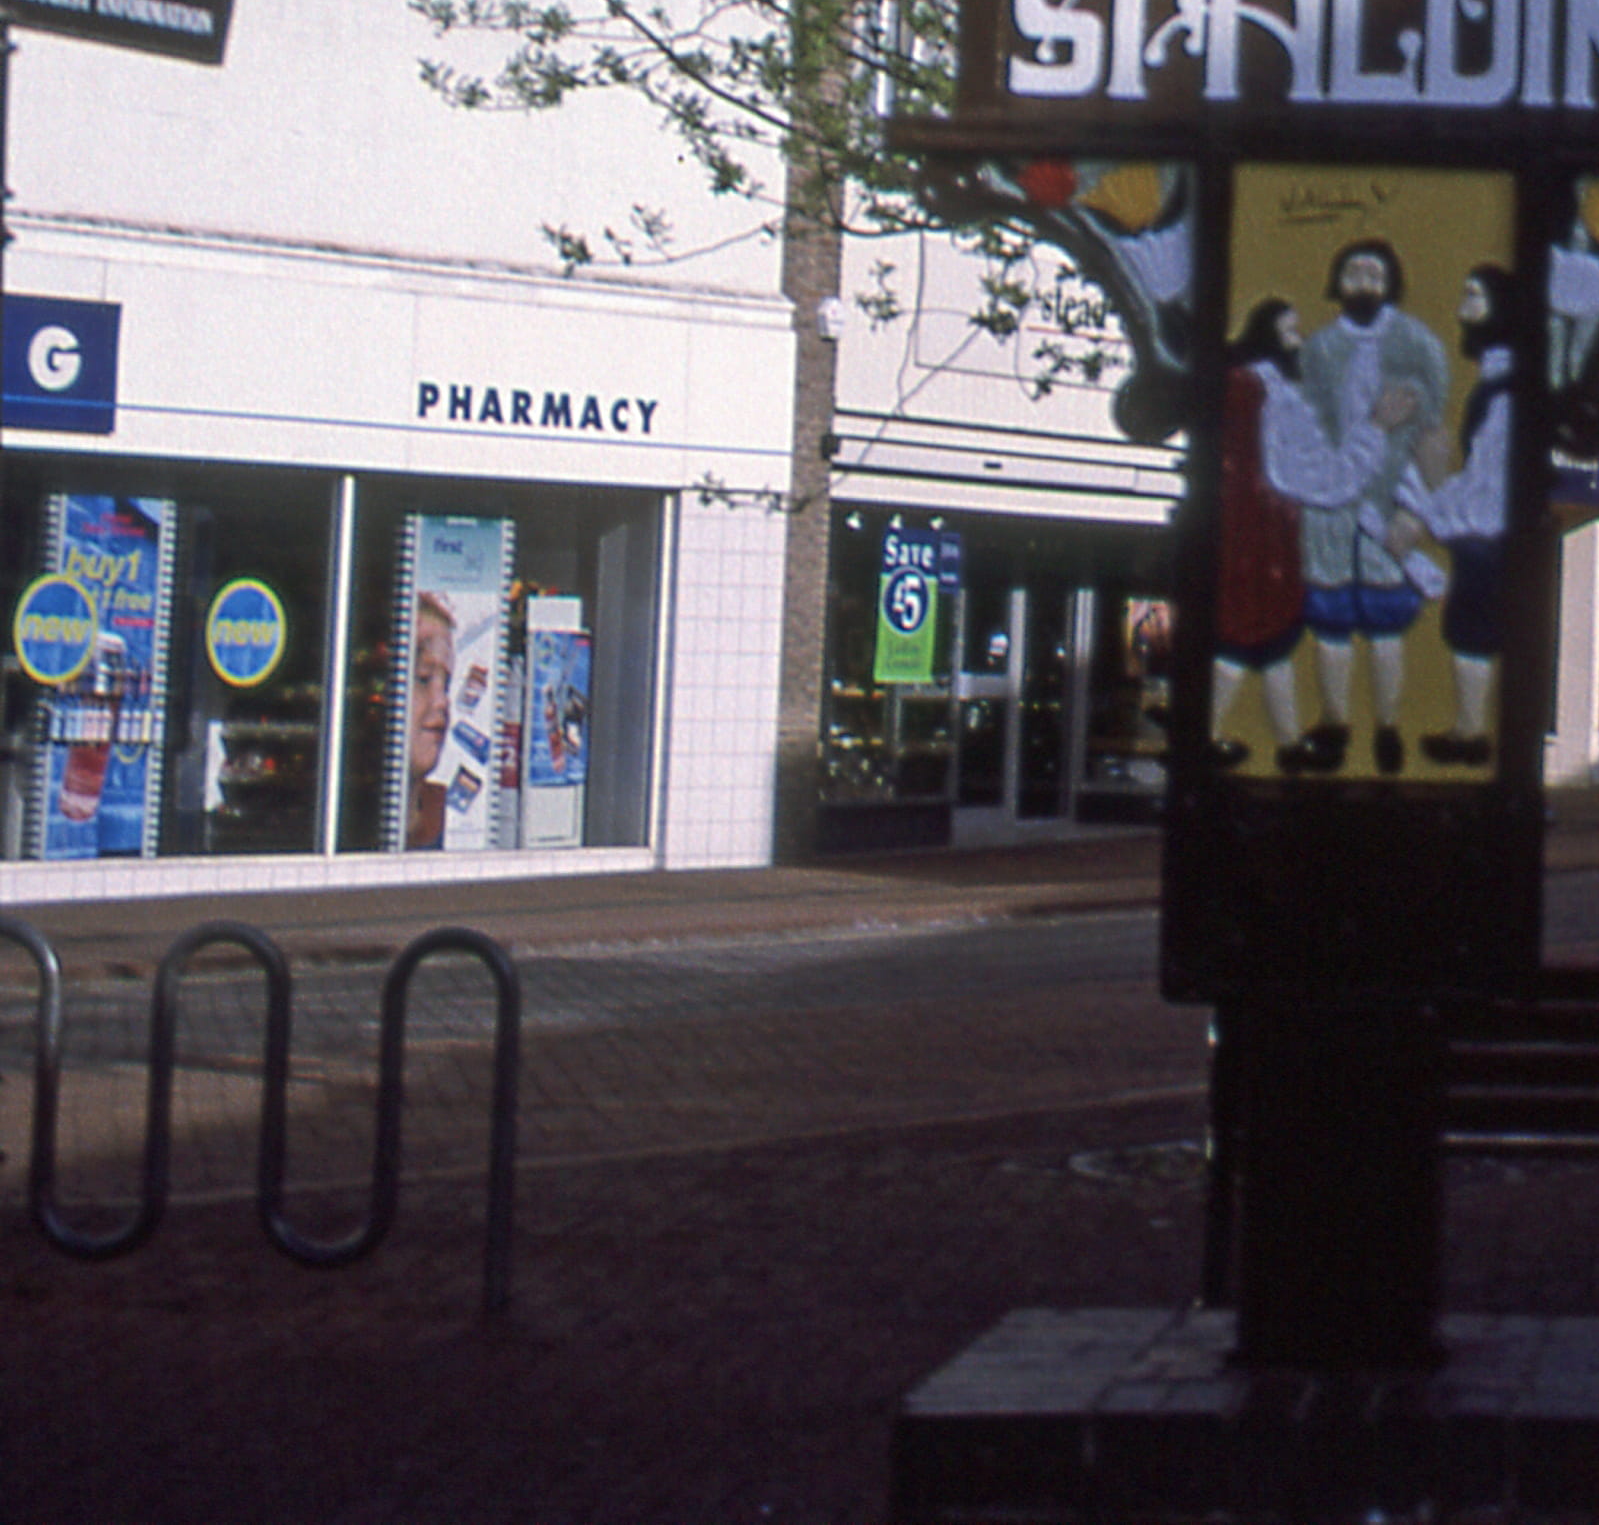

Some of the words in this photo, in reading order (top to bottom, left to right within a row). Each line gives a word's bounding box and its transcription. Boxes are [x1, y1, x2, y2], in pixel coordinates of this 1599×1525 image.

[27, 324, 83, 393] G
[417, 382, 660, 435] PHARMACY
[884, 533, 936, 571] Save
[22, 612, 90, 644] new
[214, 617, 278, 647] new
